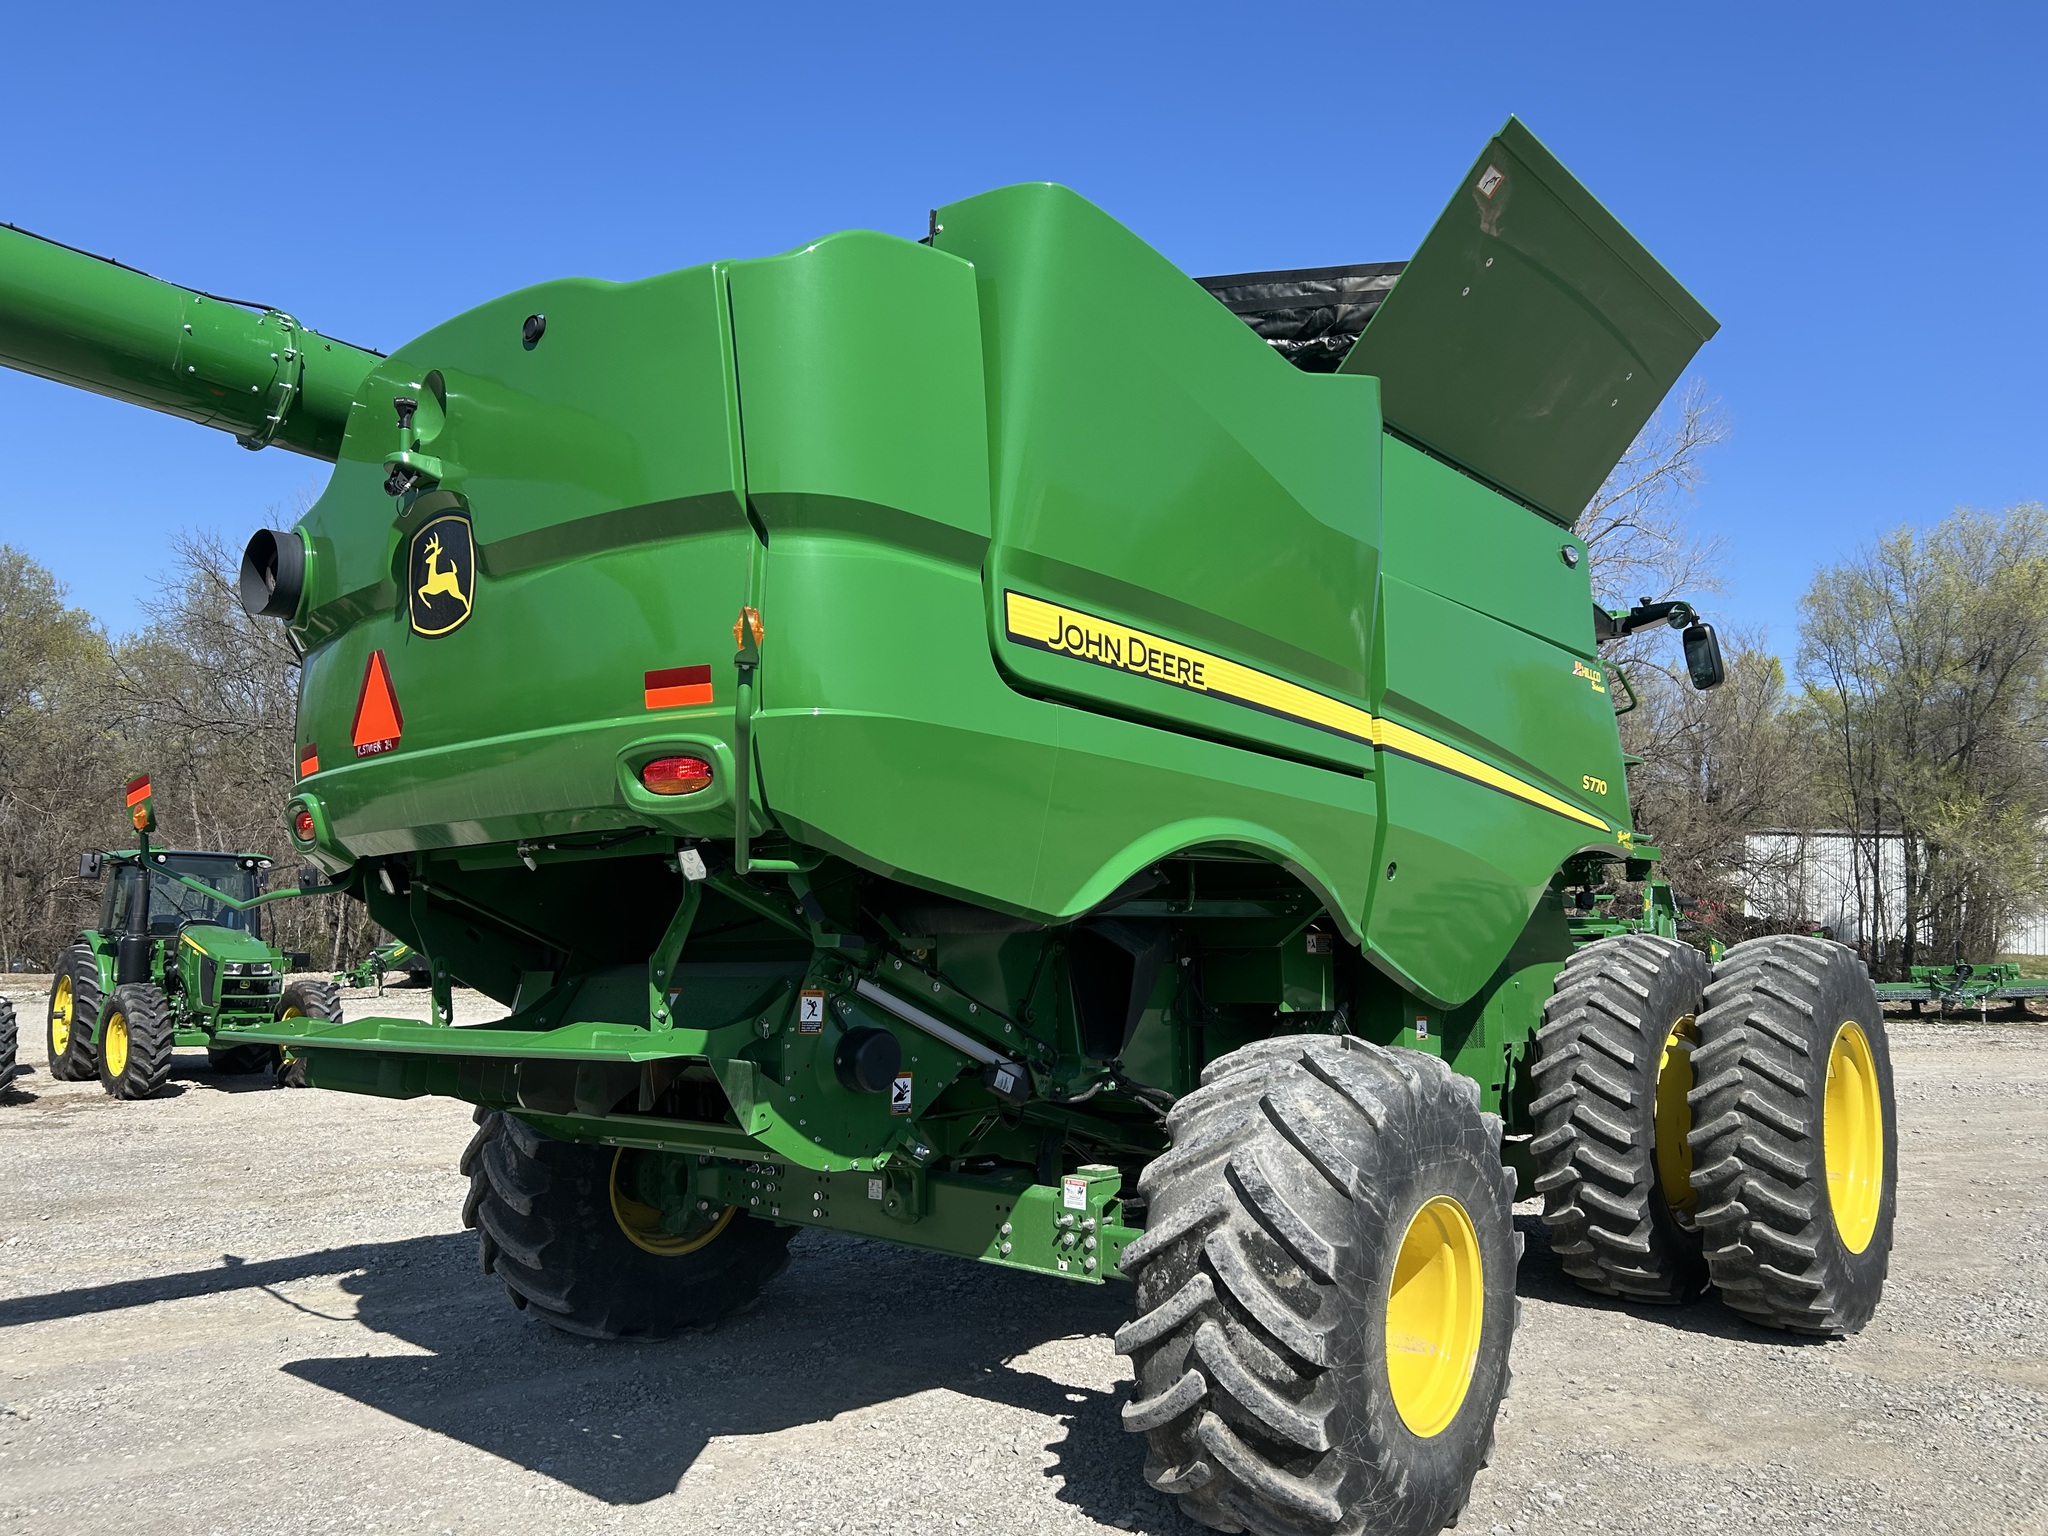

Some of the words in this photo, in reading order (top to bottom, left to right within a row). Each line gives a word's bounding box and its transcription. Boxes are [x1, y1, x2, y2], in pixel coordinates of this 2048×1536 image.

[1048, 615, 1121, 662] JOHN
[1128, 636, 1205, 686] DEERE
[1582, 774, 1608, 796] S770
